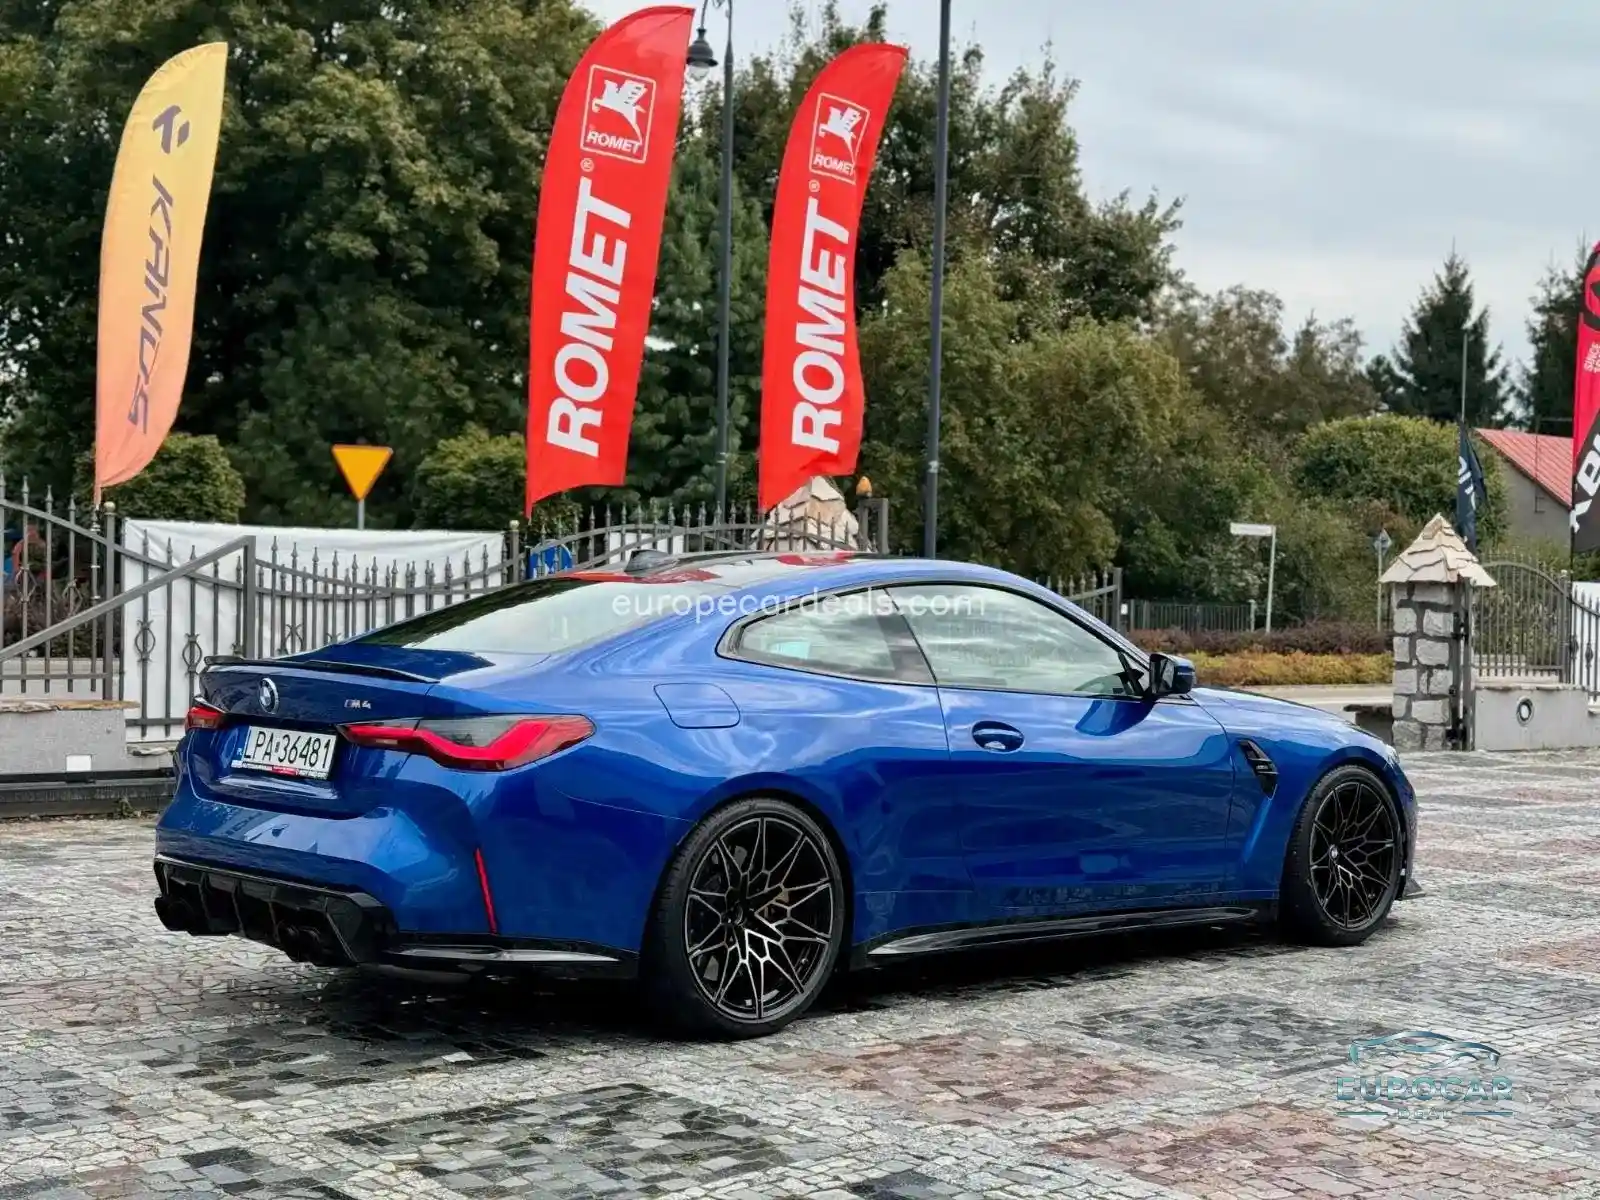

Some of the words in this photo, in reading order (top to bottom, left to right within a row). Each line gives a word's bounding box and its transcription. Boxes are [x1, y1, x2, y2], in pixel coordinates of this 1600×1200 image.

[586, 130, 643, 154] ROMET
[813, 153, 856, 176] ROMET
[546, 176, 632, 457] ROMET
[791, 196, 850, 455] ROMET
[243, 728, 275, 762] LPA
[278, 733, 332, 770] 36481
